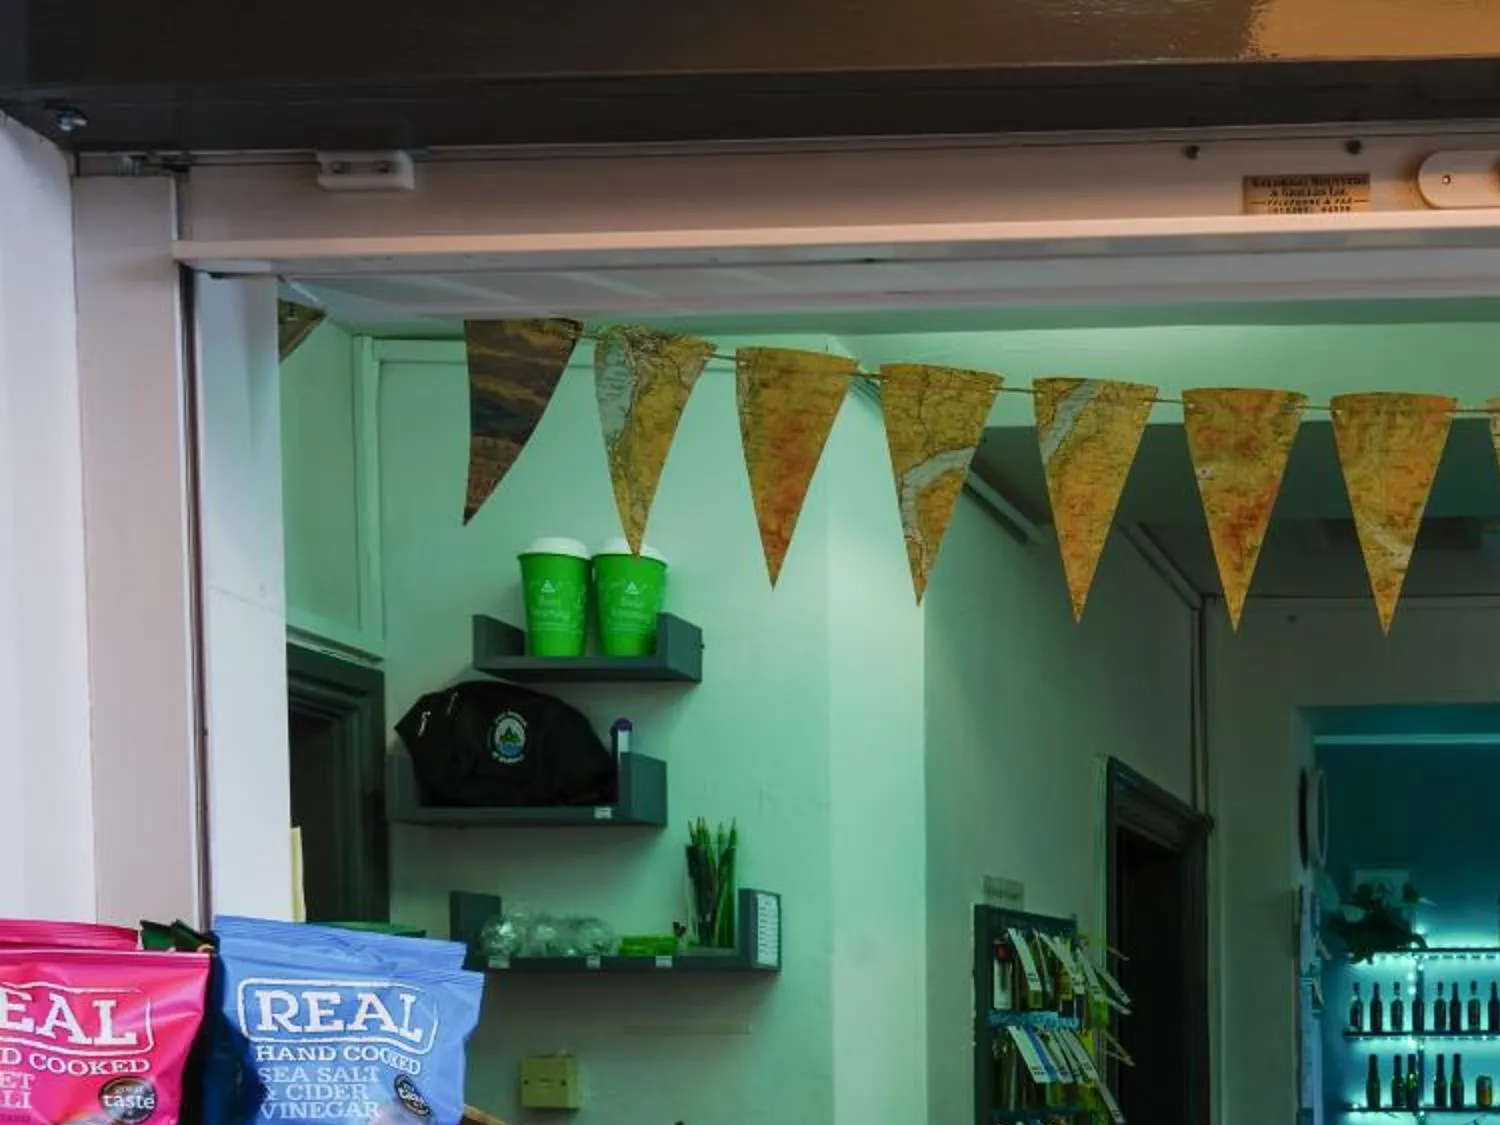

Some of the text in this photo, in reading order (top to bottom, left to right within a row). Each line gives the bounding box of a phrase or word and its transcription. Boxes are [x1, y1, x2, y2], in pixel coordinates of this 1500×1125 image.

[0, 986, 138, 1045] EAL
[255, 989, 424, 1044] REAL
[255, 1045, 337, 1062] HAND
[28, 1053, 151, 1077] COOKED
[258, 1066, 380, 1083] SEA SALT
[285, 1084, 369, 1101] CIDER
[102, 1095, 155, 1110] taste
[260, 1102, 382, 1120] VINEGAR
